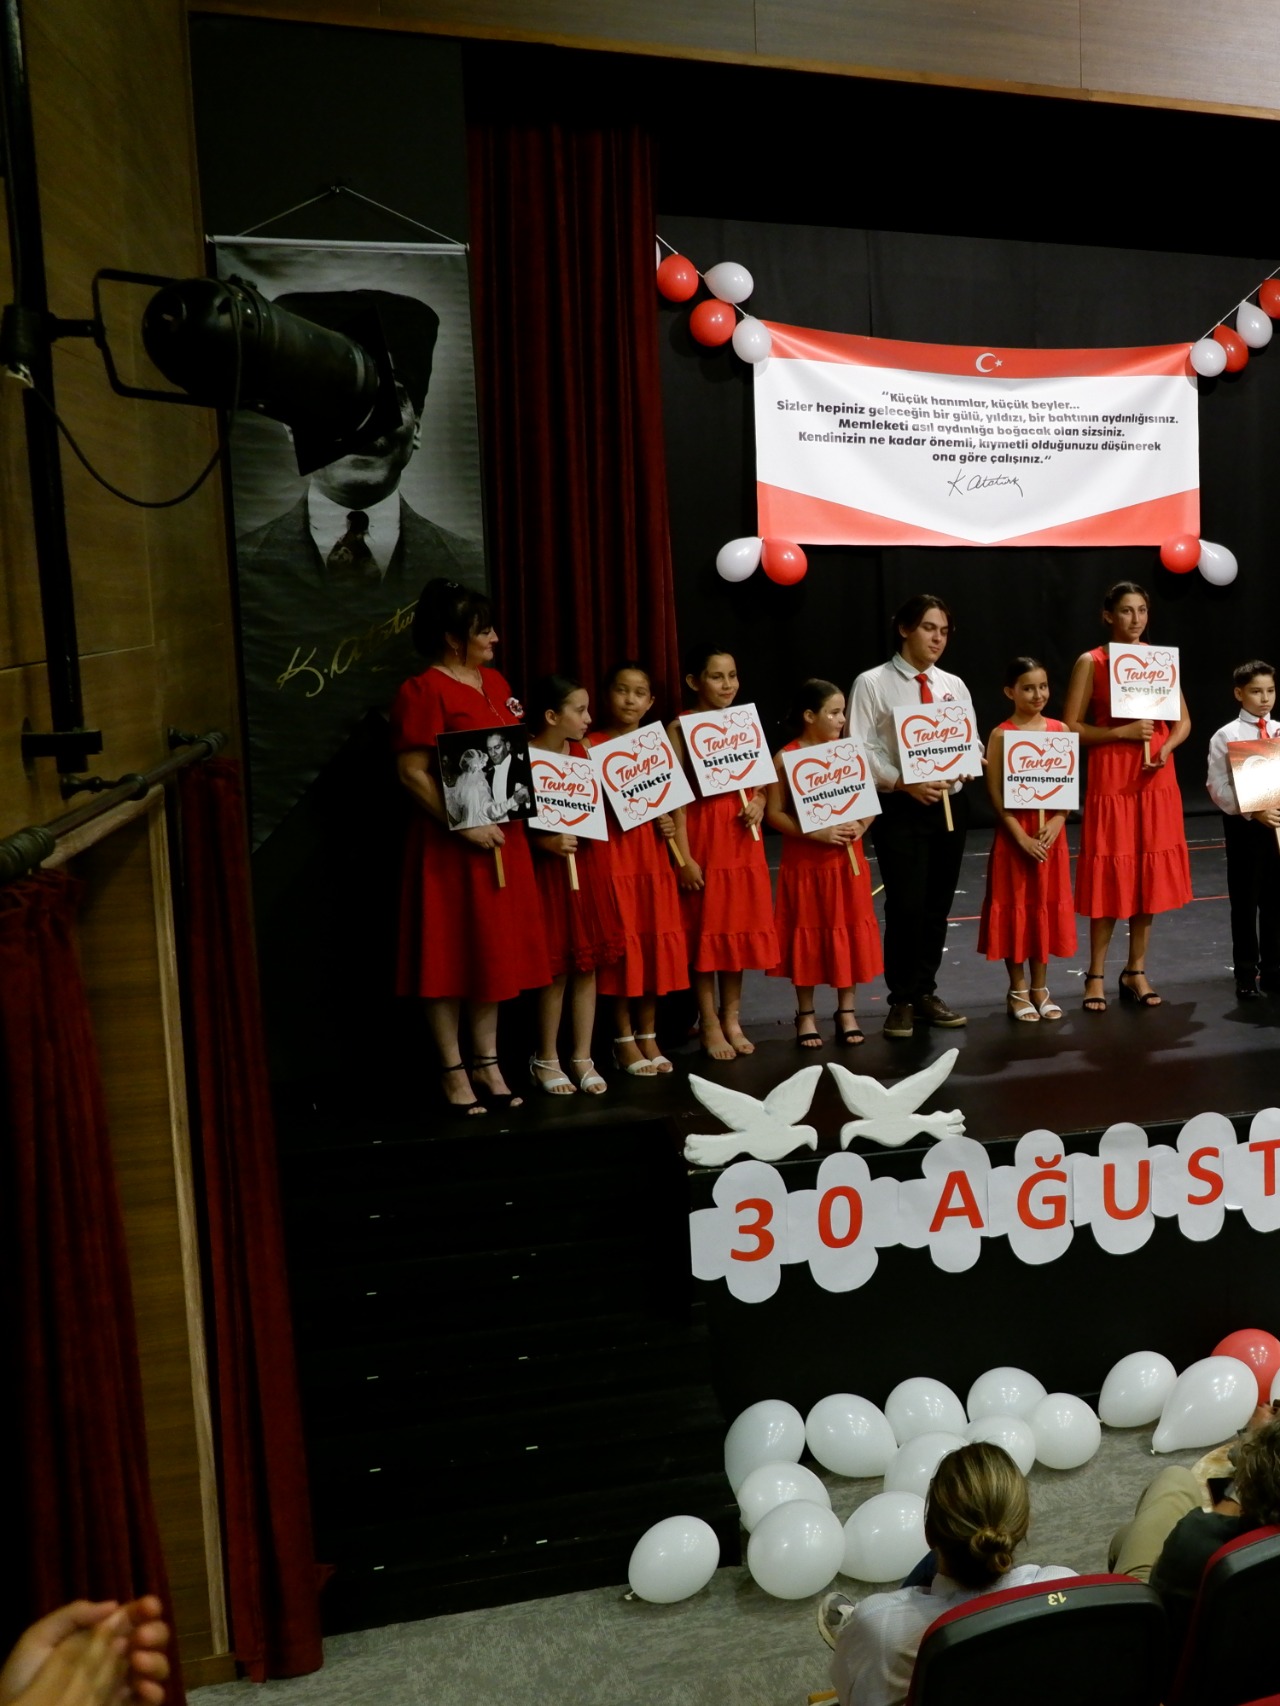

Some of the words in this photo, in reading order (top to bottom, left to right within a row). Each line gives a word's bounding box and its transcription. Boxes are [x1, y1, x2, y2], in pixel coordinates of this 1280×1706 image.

[777, 400, 813, 412] Sizler
[816, 402, 865, 415] hepiniz
[869, 405, 930, 419] geleceğin
[933, 409, 949, 419] bir
[953, 411, 983, 422] gülü,
[986, 412, 1026, 424] yıldızı,
[1029, 413, 1045, 423] bir
[1048, 413, 1099, 423] bahtının
[1102, 413, 1178, 425] aydınlığısınız.
[931, 396, 988, 410] hanımlar,
[991, 399, 1029, 411] küçük
[1032, 401, 1080, 412] beyler...
[838, 418, 909, 431] Memleketi
[912, 421, 934, 432] asıl
[937, 424, 994, 436] aydınlığa
[997, 425, 1051, 437] boğacak
[1054, 427, 1079, 436] olan
[1082, 427, 1125, 437] sizsiniz.
[798, 431, 866, 445] Kendinizin
[869, 437, 885, 445] ne
[889, 435, 926, 446] kadar
[929, 436, 976, 449] önemli,
[979, 438, 1028, 449] kıymetli
[1032, 440, 1098, 452] olduğunuzu
[1101, 441, 1161, 452] düşünerek
[932, 453, 956, 462] ona
[959, 452, 987, 464] göre
[1124, 667, 1165, 683] Tango
[1121, 684, 1171, 697] sevgidir
[703, 730, 748, 756] Tango
[913, 725, 959, 744] Tango
[702, 748, 760, 768] birliktir
[908, 743, 972, 759] paylaşımdır
[615, 754, 659, 783] Tango
[1019, 755, 1063, 772] Tango
[805, 764, 852, 787] Tango
[1007, 773, 1075, 785] dayanışmadır
[539, 776, 585, 797] Tango
[621, 772, 672, 799] iyiliktir
[802, 782, 866, 804] mutluluktur
[536, 795, 596, 813] nezakettir
[729, 1185, 864, 1262] 30
[1047, 1592, 1067, 1606] 13
